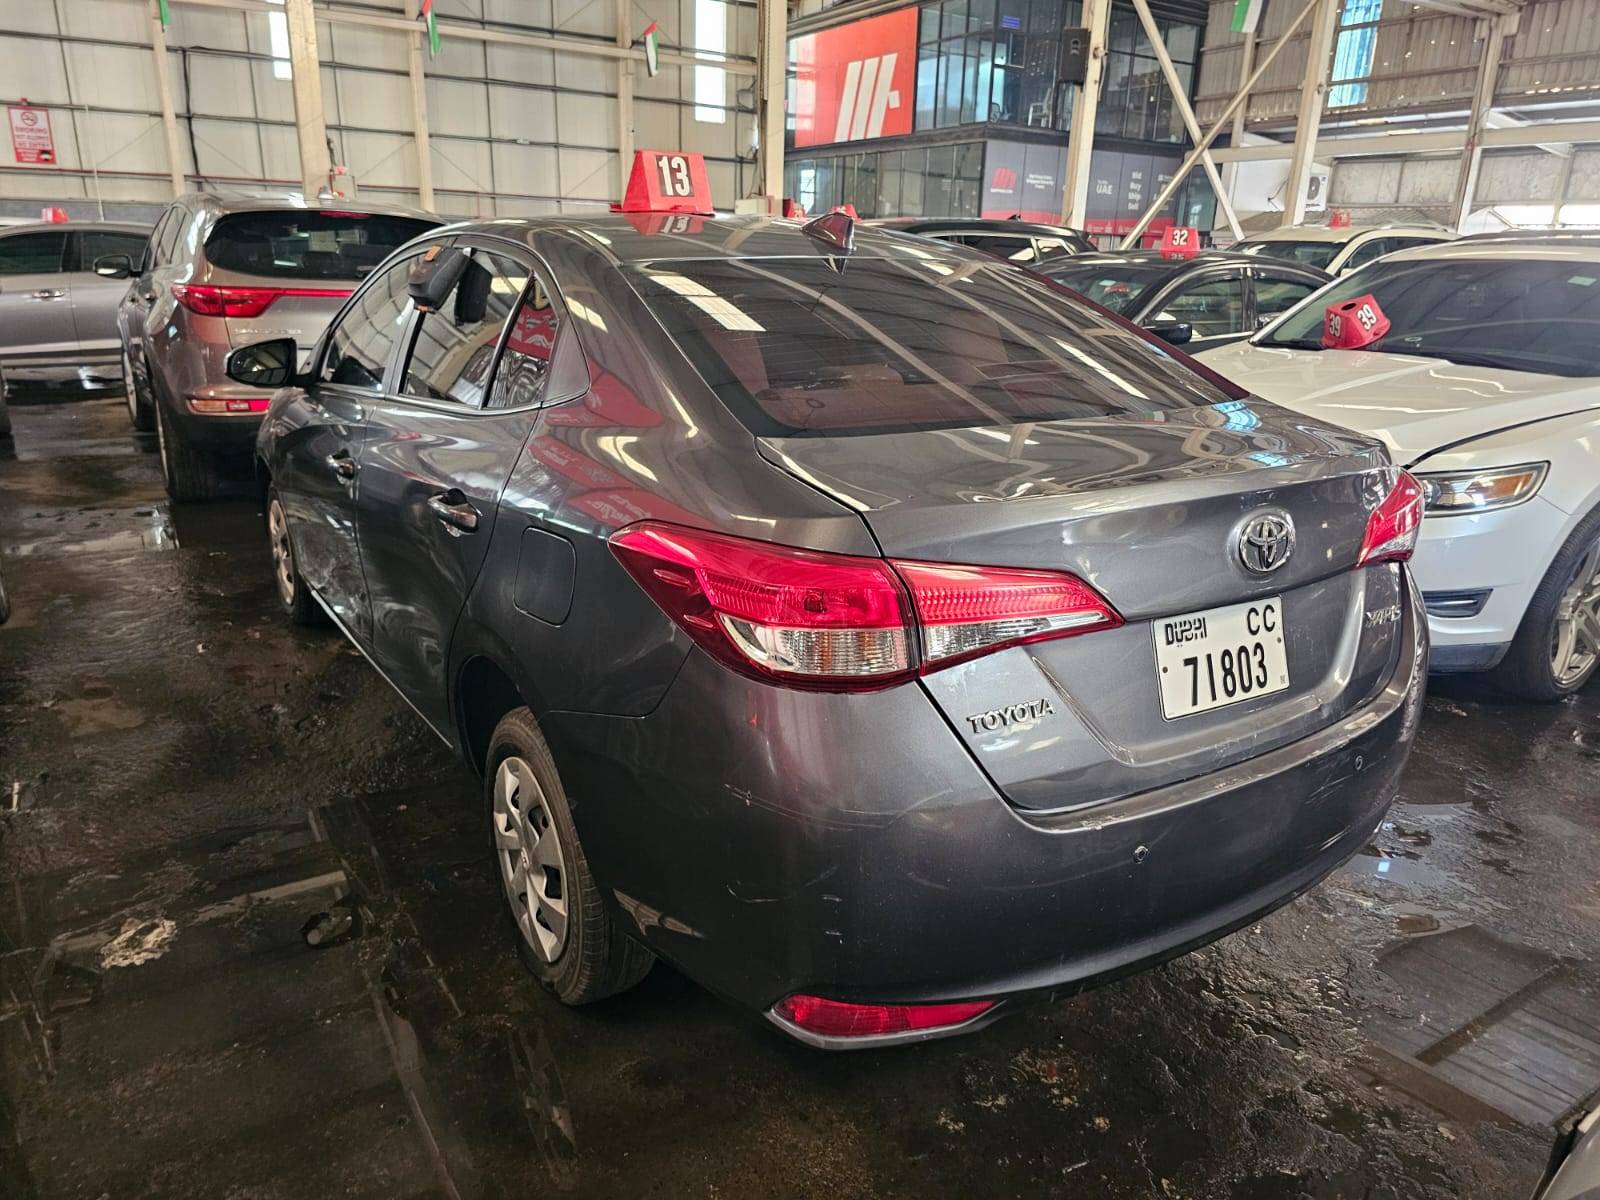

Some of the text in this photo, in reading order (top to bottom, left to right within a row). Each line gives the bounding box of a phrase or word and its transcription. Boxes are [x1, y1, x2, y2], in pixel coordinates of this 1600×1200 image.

[658, 155, 691, 197] 13
[1096, 184, 1113, 195] UAE
[1172, 229, 1189, 246] 32
[1328, 313, 1341, 337] 39
[1357, 303, 1377, 330] 39
[1246, 604, 1276, 636] CC
[1182, 641, 1268, 707] 71803
[966, 698, 1056, 734] TOYOTA
